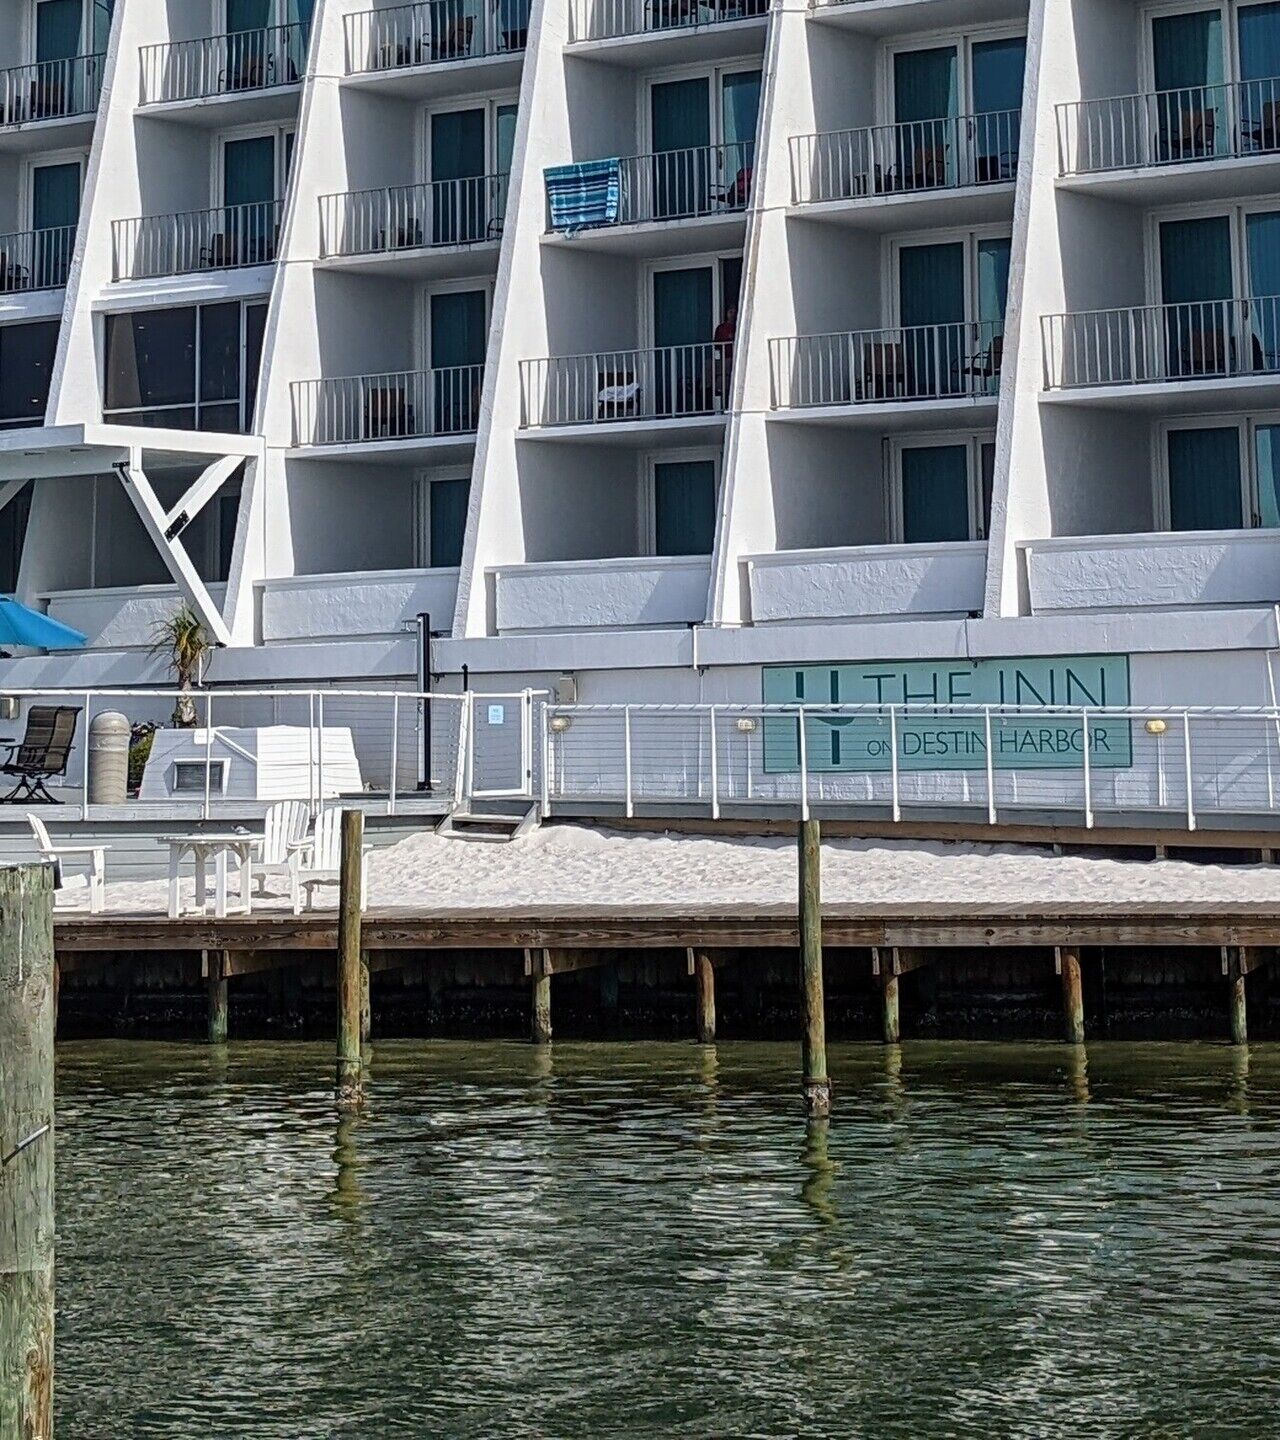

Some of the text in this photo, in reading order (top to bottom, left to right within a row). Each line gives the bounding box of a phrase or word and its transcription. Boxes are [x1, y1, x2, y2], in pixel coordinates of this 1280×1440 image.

[863, 667, 1106, 720] THE INN
[903, 730, 989, 755] DESTIN
[999, 727, 1111, 753] HARBOR
